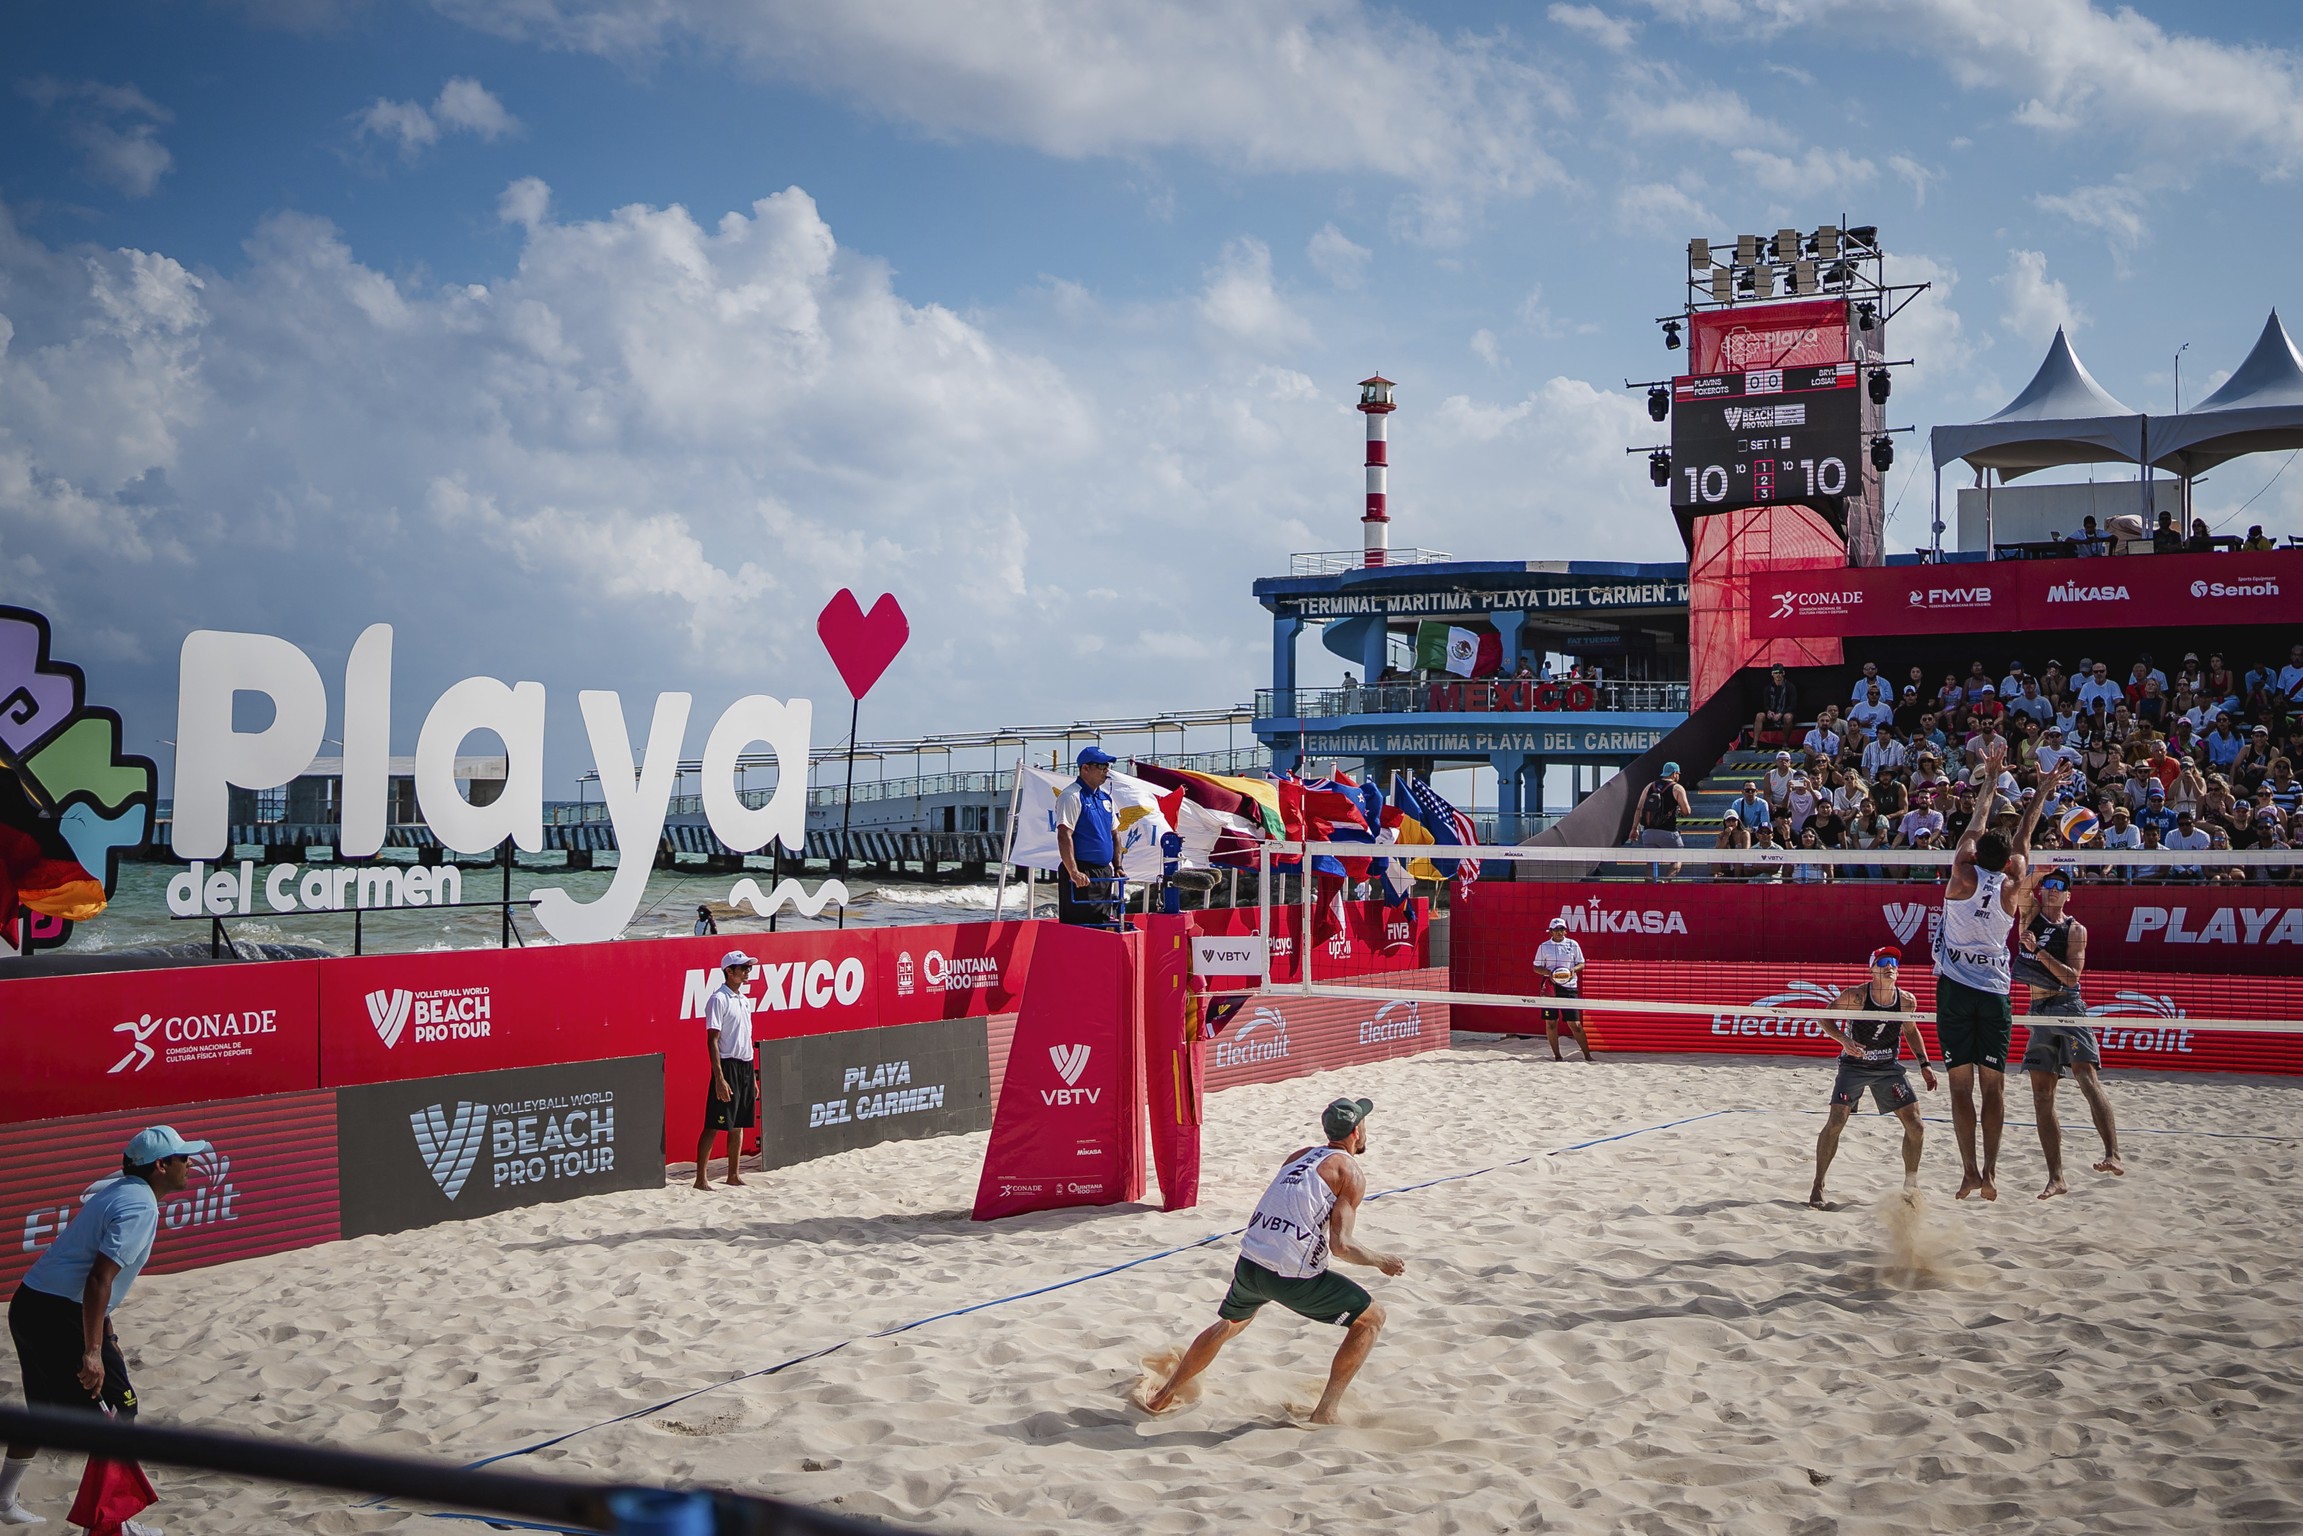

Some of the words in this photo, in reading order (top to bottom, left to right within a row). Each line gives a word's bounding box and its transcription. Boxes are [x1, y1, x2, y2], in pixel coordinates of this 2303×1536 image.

[1818, 368, 1836, 377] BRYL
[1694, 378, 1722, 387] PLAVINS
[1750, 376, 1760, 388] 0
[1768, 375, 1778, 387] 0
[1694, 386, 1729, 396] FOKEROTS
[1742, 411, 1774, 421] BEACH
[1742, 421, 1755, 430] PRO
[1756, 420, 1774, 429] TOUR
[1750, 440, 1770, 450] SET
[1772, 438, 1777, 449] 1
[1735, 464, 1747, 474] 10
[1762, 462, 1767, 472] 1
[1782, 460, 1794, 471] 10
[1684, 464, 1729, 503] 10
[1761, 475, 1769, 486] 2
[1800, 456, 1847, 497] 10
[1761, 488, 1769, 500] 3
[1928, 587, 1992, 604] FMVB
[2210, 582, 2280, 597] Senoh
[1299, 595, 1382, 615] TERMINAL
[1386, 591, 1473, 613] MARITIMA
[1481, 589, 1540, 609] PLAYA
[1548, 588, 1581, 607] DEL
[1798, 591, 1863, 606] CONADE
[1430, 682, 1593, 712] MEXICO
[1387, 734, 1470, 752] MARITIMA
[1476, 733, 1536, 751] PLAYA
[1543, 733, 1576, 750] DEL
[171, 622, 813, 943] Playa
[166, 861, 253, 916] del
[265, 863, 461, 913] Carmen
[1981, 894, 1992, 909] 1
[1974, 909, 1991, 920] BRYL
[1387, 922, 1410, 940] FIVB
[2125, 906, 2303, 945] PLAYA
[2037, 934, 2051, 947] 2
[1217, 951, 1251, 961] VBTV
[924, 949, 998, 986] QUINTANA
[945, 973, 972, 990] ROO
[414, 988, 462, 1000] VOLLEYBALL
[463, 986, 491, 997] WORLD
[414, 995, 491, 1025] BEACH
[165, 1009, 277, 1042] CONADE
[414, 1022, 448, 1043] PRO
[448, 1020, 492, 1041] TOUR
[1360, 1015, 1421, 1045] Electrolit
[1711, 1013, 1850, 1038] Electro
[1875, 1023, 1887, 1035] 1
[2098, 1026, 2195, 1053] trolit
[166, 1044, 199, 1056] COMISIÓN
[199, 1043, 231, 1053] NACIONAL
[232, 1041, 242, 1050] DE
[166, 1054, 196, 1064] CULTURA
[217, 1050, 223, 1059] Y
[223, 1047, 253, 1058] DEPORTE
[1216, 1035, 1291, 1068] Electrolit
[1863, 1048, 1893, 1056] UINTANA
[843, 1060, 912, 1093] PLAYA
[493, 1098, 571, 1116] VOLLEYBALL
[573, 1090, 615, 1108] WORLD
[1040, 1087, 1101, 1106] VBTV
[810, 1100, 852, 1129] DEL
[856, 1084, 945, 1121] CARMEN
[492, 1104, 616, 1159] BEACH
[493, 1158, 547, 1189] PRO
[547, 1146, 616, 1184] TOUR
[1288, 1164, 1309, 1177] 2
[22, 1183, 241, 1252] Elolit
[1262, 1215, 1311, 1241] VBTV
